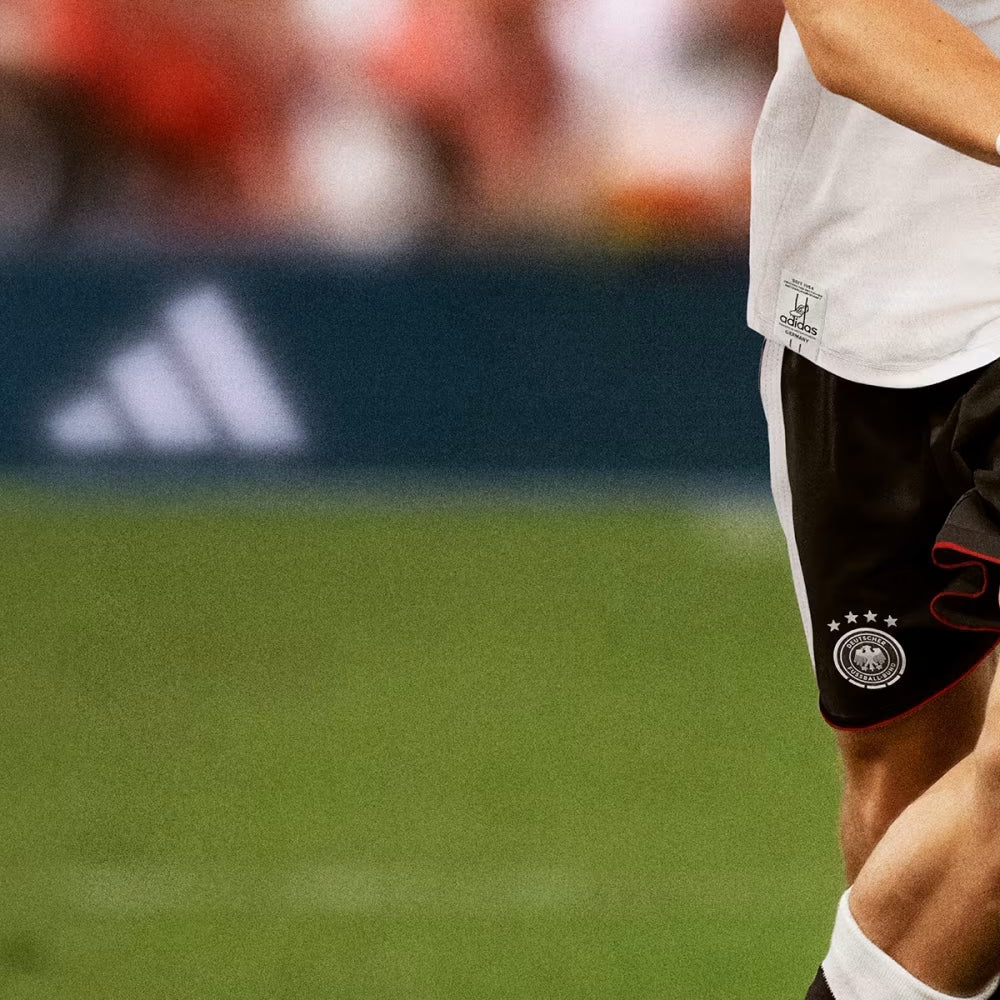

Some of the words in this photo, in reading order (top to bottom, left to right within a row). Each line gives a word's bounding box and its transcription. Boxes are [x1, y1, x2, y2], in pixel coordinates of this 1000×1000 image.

[779, 314, 818, 336] adidas
[846, 635, 887, 649] DEUTSCHER
[846, 662, 896, 681] FUSSBALL-BUND
